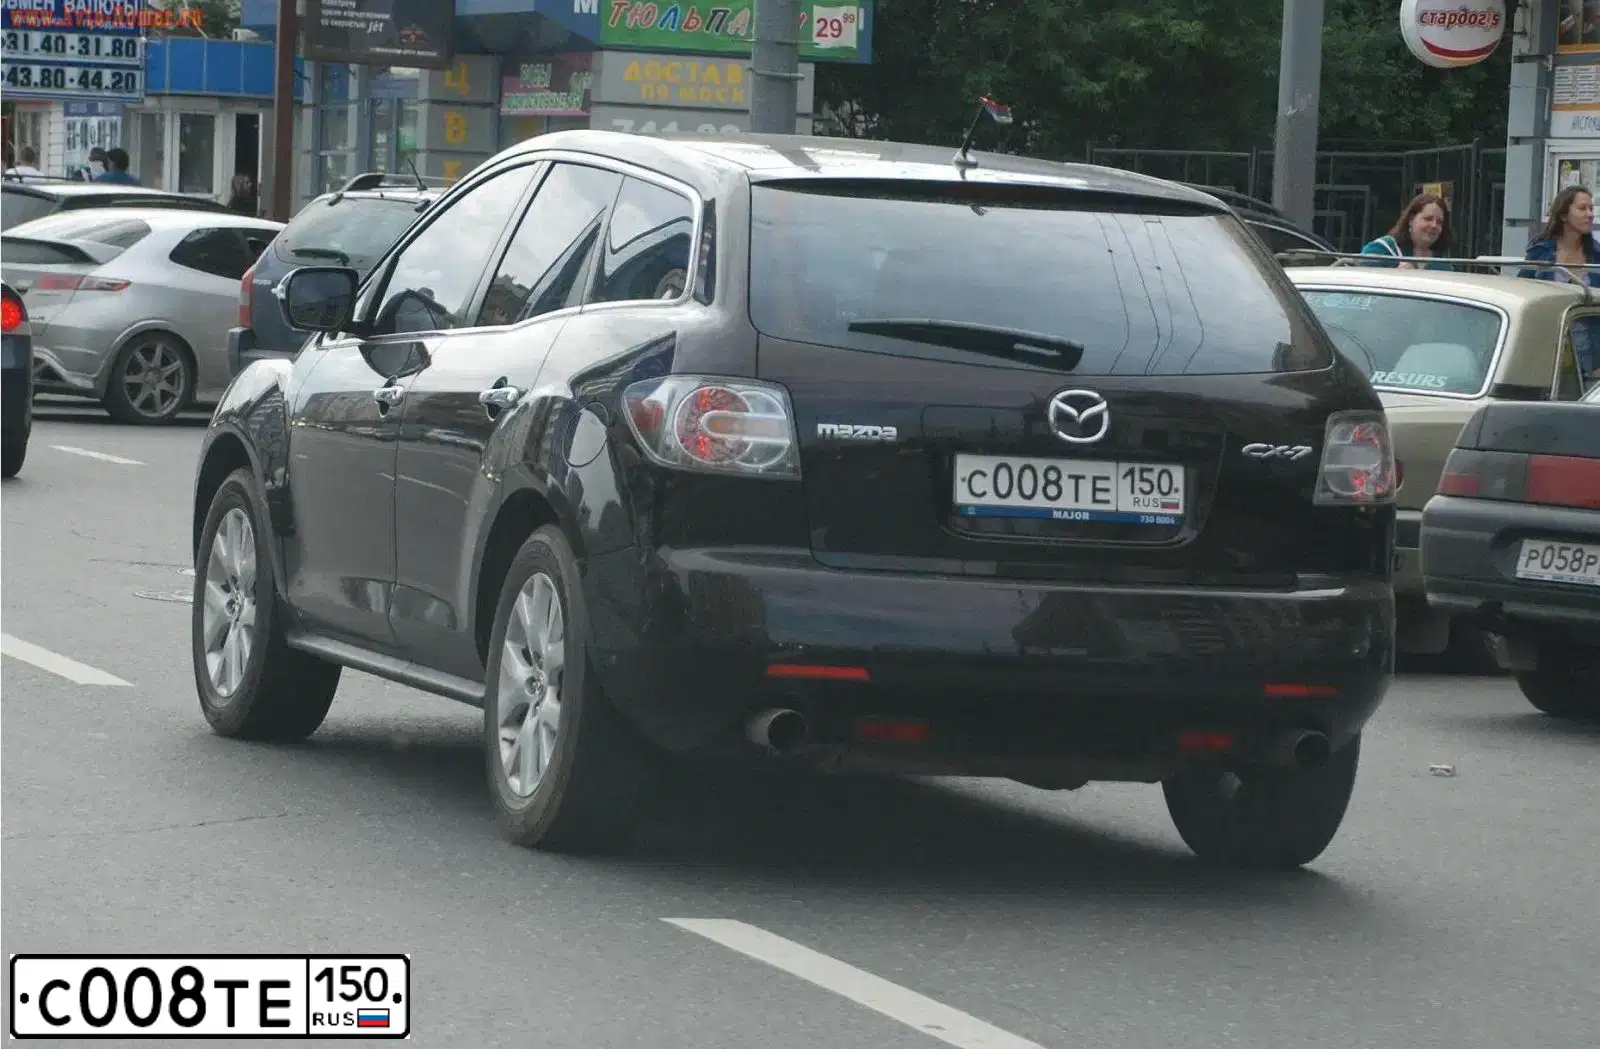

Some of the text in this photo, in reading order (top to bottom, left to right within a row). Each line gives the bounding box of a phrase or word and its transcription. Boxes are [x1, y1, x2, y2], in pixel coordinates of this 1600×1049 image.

[816, 18, 842, 40] 29
[1370, 370, 1448, 388] RESURS
[1241, 442, 1313, 461] CX-7
[1121, 465, 1174, 497] 150
[1132, 496, 1160, 508] RUS
[1052, 509, 1091, 521] MAJOR
[1524, 543, 1600, 576] Р058Р
